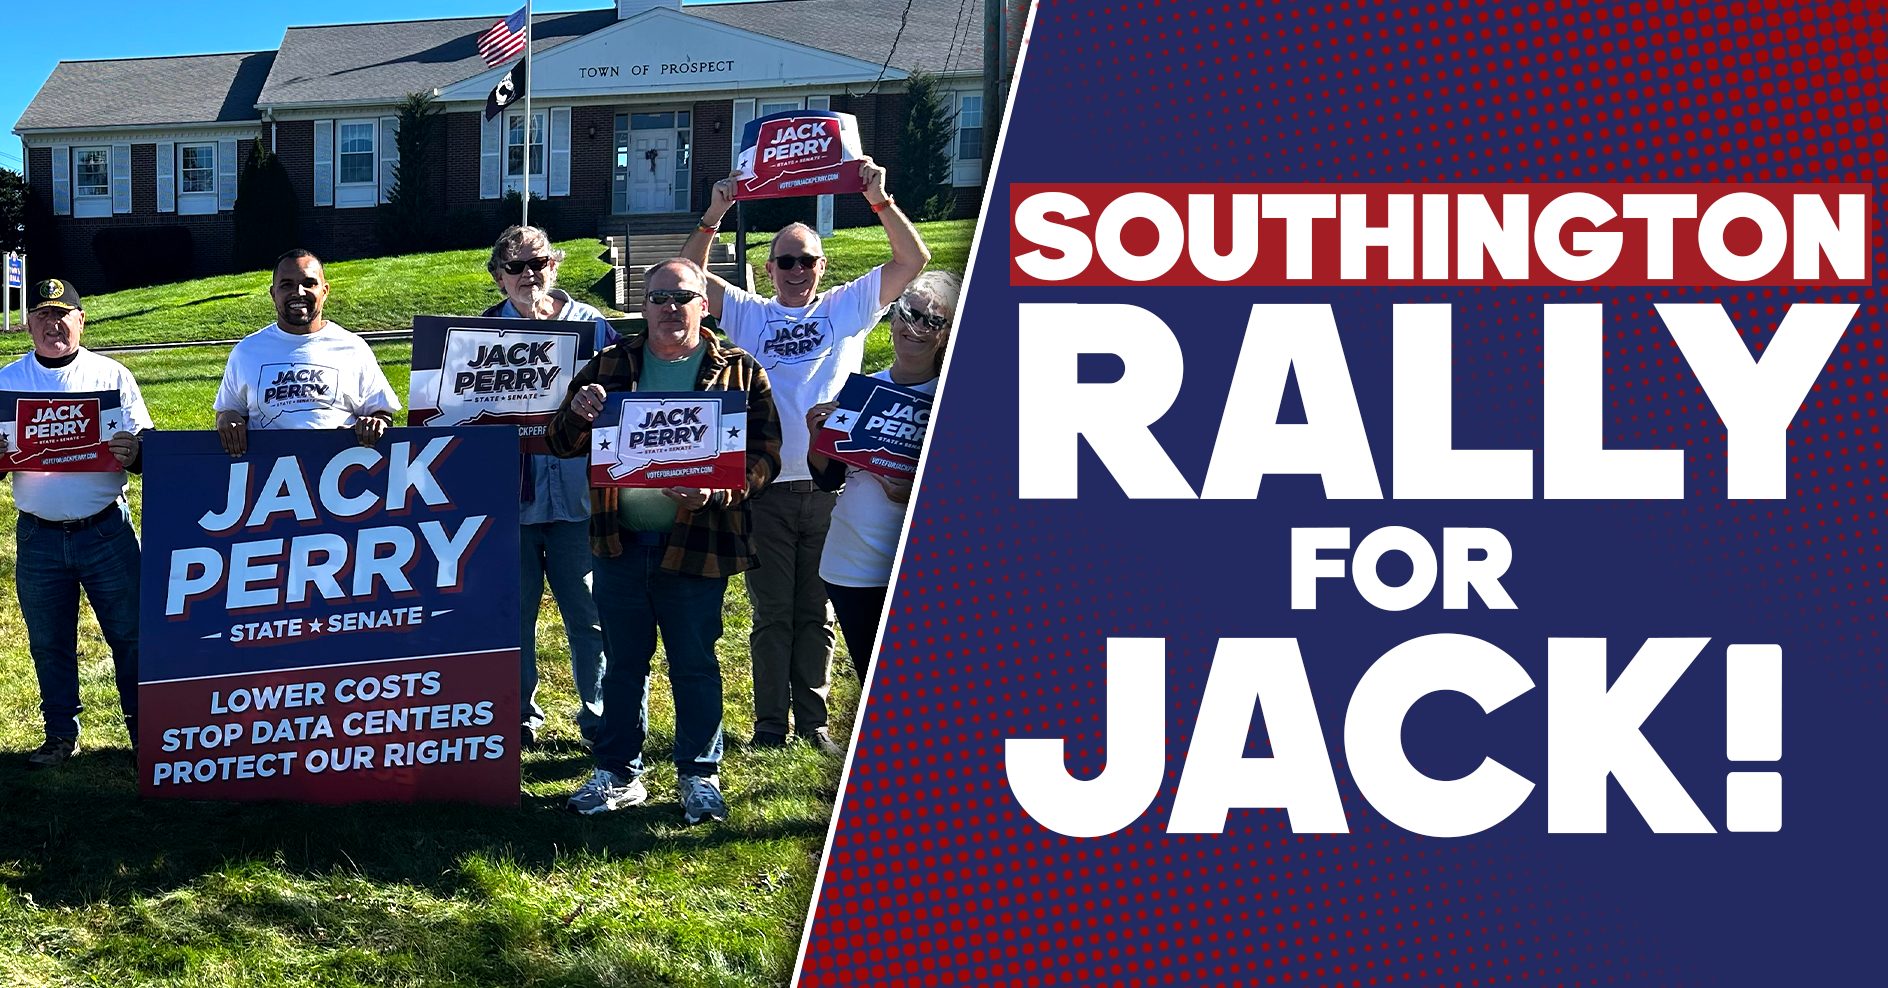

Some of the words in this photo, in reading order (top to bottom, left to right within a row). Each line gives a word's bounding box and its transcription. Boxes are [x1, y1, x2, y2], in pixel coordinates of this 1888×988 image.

[579, 66, 620, 78] TOWN
[631, 65, 650, 76] OF
[660, 60, 735, 75] PROSPECT
[770, 121, 827, 145] JACK
[762, 136, 833, 163] PERRY
[776, 160, 795, 168] STATE
[799, 155, 821, 164] SENATE
[779, 173, 839, 190] VOTEFORJACKPERRY.COM
[772, 321, 819, 342] JACK
[467, 340, 556, 370] JACK
[763, 334, 826, 357] PERRY
[271, 369, 324, 386] JACK
[453, 365, 562, 396] PERRY
[264, 383, 329, 404] PERRY
[507, 392, 538, 401] SENATE
[31, 403, 85, 423] JACK
[638, 406, 705, 429] JACK
[25, 418, 91, 439] PERRY
[628, 423, 709, 450] PERRY
[877, 436, 899, 446] STATE
[904, 442, 921, 450] SENA
[198, 435, 456, 532] JACK
[646, 466, 714, 480] VOTEFORJACKPERRY.COM
[165, 515, 488, 616] PERRY
[229, 618, 303, 643] STATE
[327, 606, 423, 632] SENATE
[210, 681, 325, 715] LOWER
[334, 671, 441, 701] COSTS
[161, 723, 243, 752] STOP
[251, 715, 335, 745] DATA
[343, 701, 494, 736] CENTERS
[153, 752, 298, 786] PROTECT
[305, 745, 374, 774] OUR
[383, 735, 505, 767] RIGHTS
